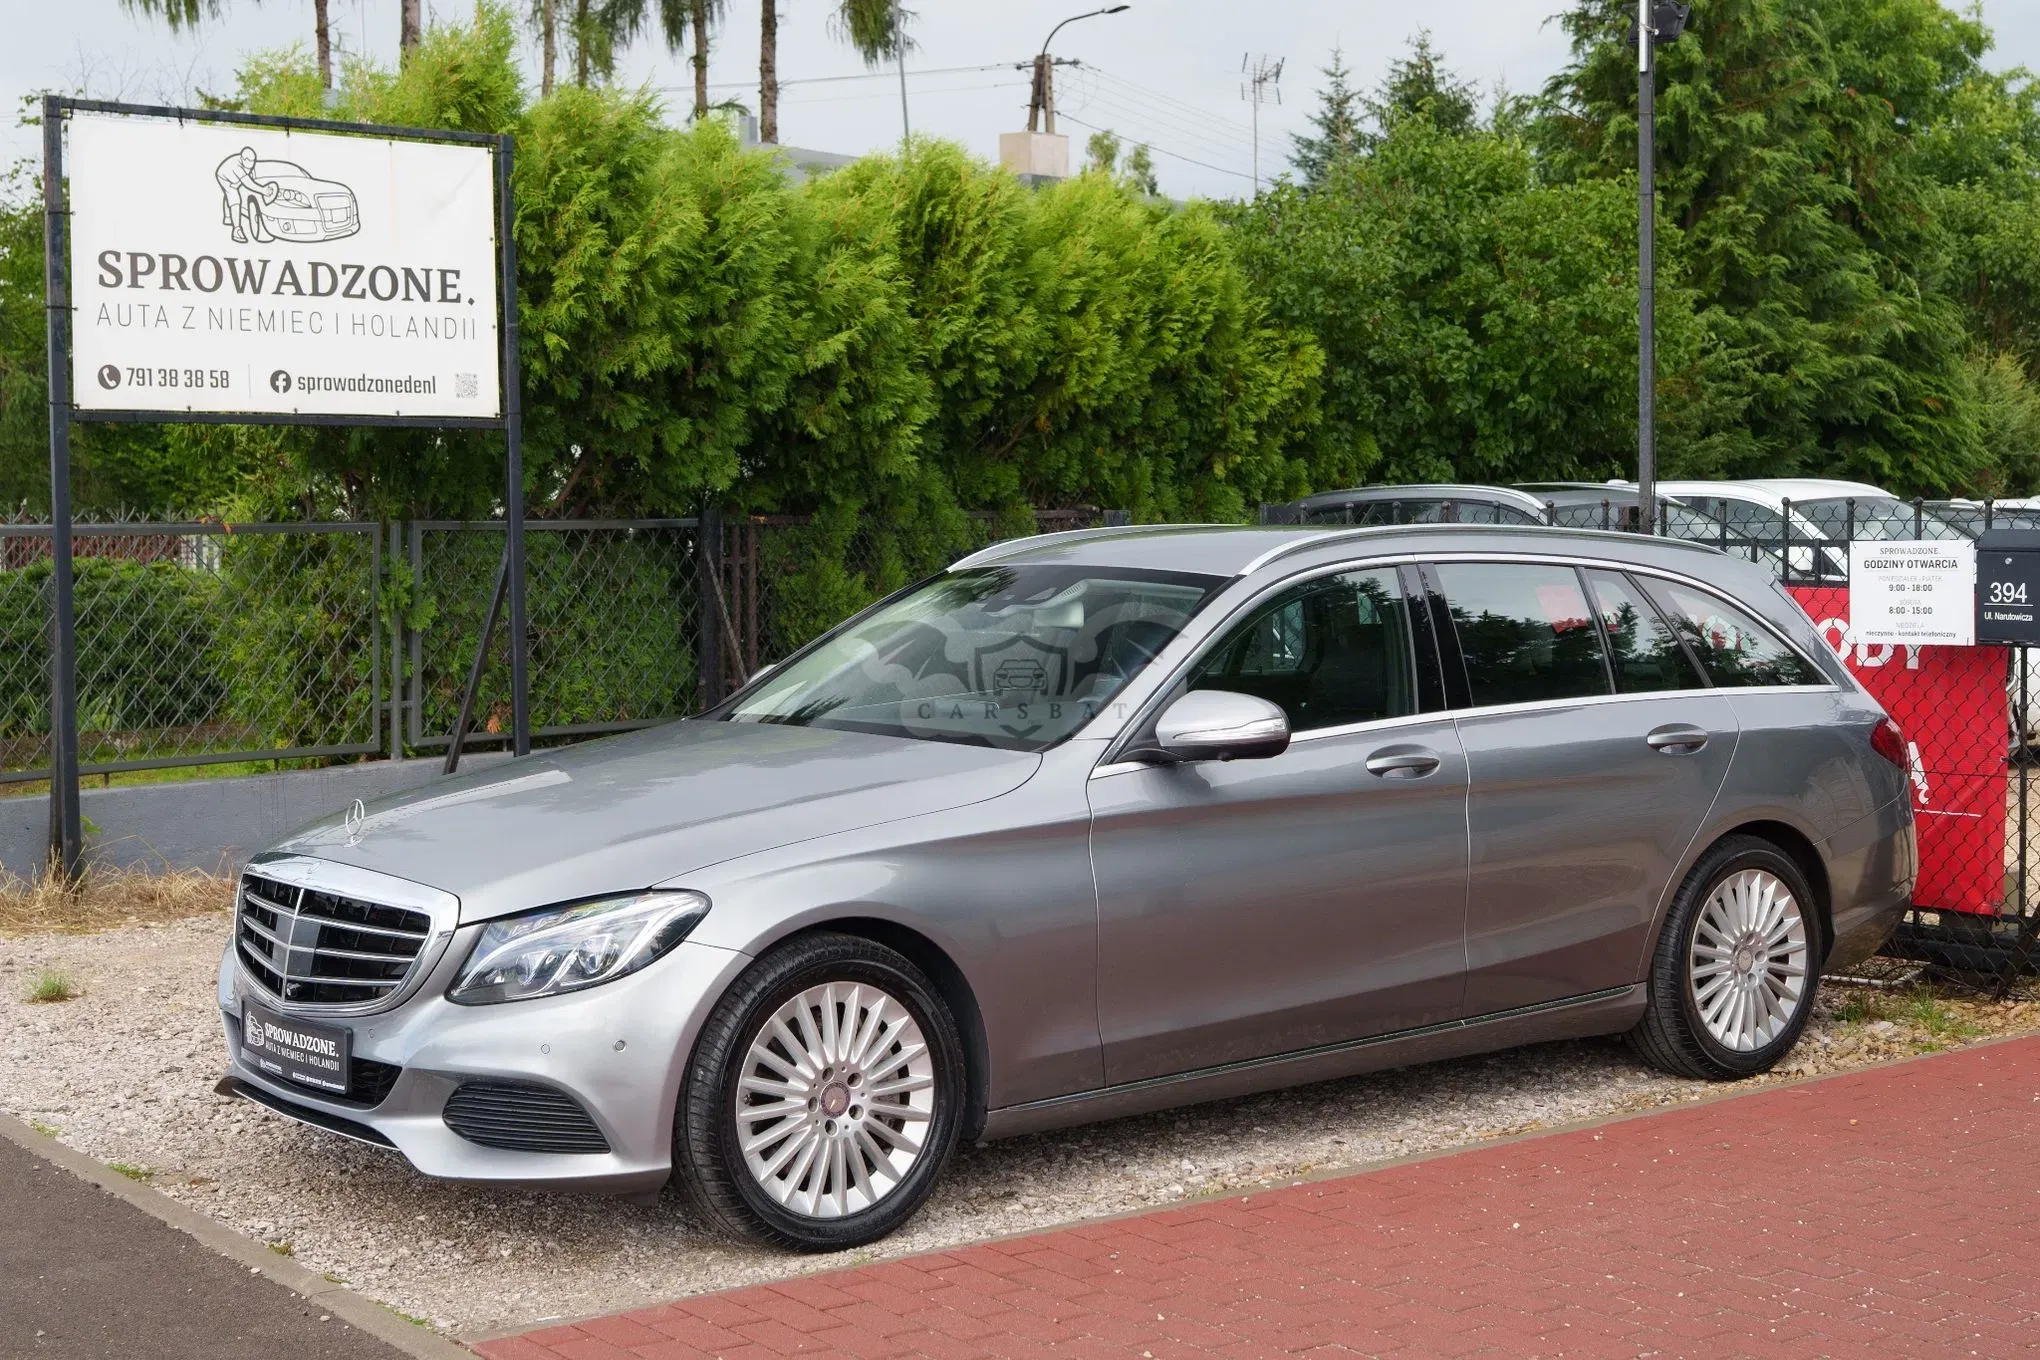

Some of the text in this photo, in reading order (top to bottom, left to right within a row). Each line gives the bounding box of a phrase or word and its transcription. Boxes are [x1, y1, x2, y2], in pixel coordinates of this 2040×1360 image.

[97, 249, 475, 306] SPROWADZONE.
[96, 302, 170, 329] AUTA
[182, 305, 196, 330] Z
[208, 307, 323, 335] NIEMIEC
[351, 313, 476, 340] HOLANDII
[126, 367, 230, 389] 791 38 38 58
[297, 372, 437, 395] sprowadzonedenl
[1863, 559, 1958, 569] GODZINY OTWARCIA
[1888, 584, 1906, 592] 9:00
[1912, 584, 1933, 592] 18:00
[1990, 581, 2028, 604] 394
[1888, 606, 1906, 615] 8:00
[1912, 606, 1933, 615] 15:00
[1994, 611, 2033, 622] Narutowicza
[264, 1022, 340, 1058] SPROWADZONE.
